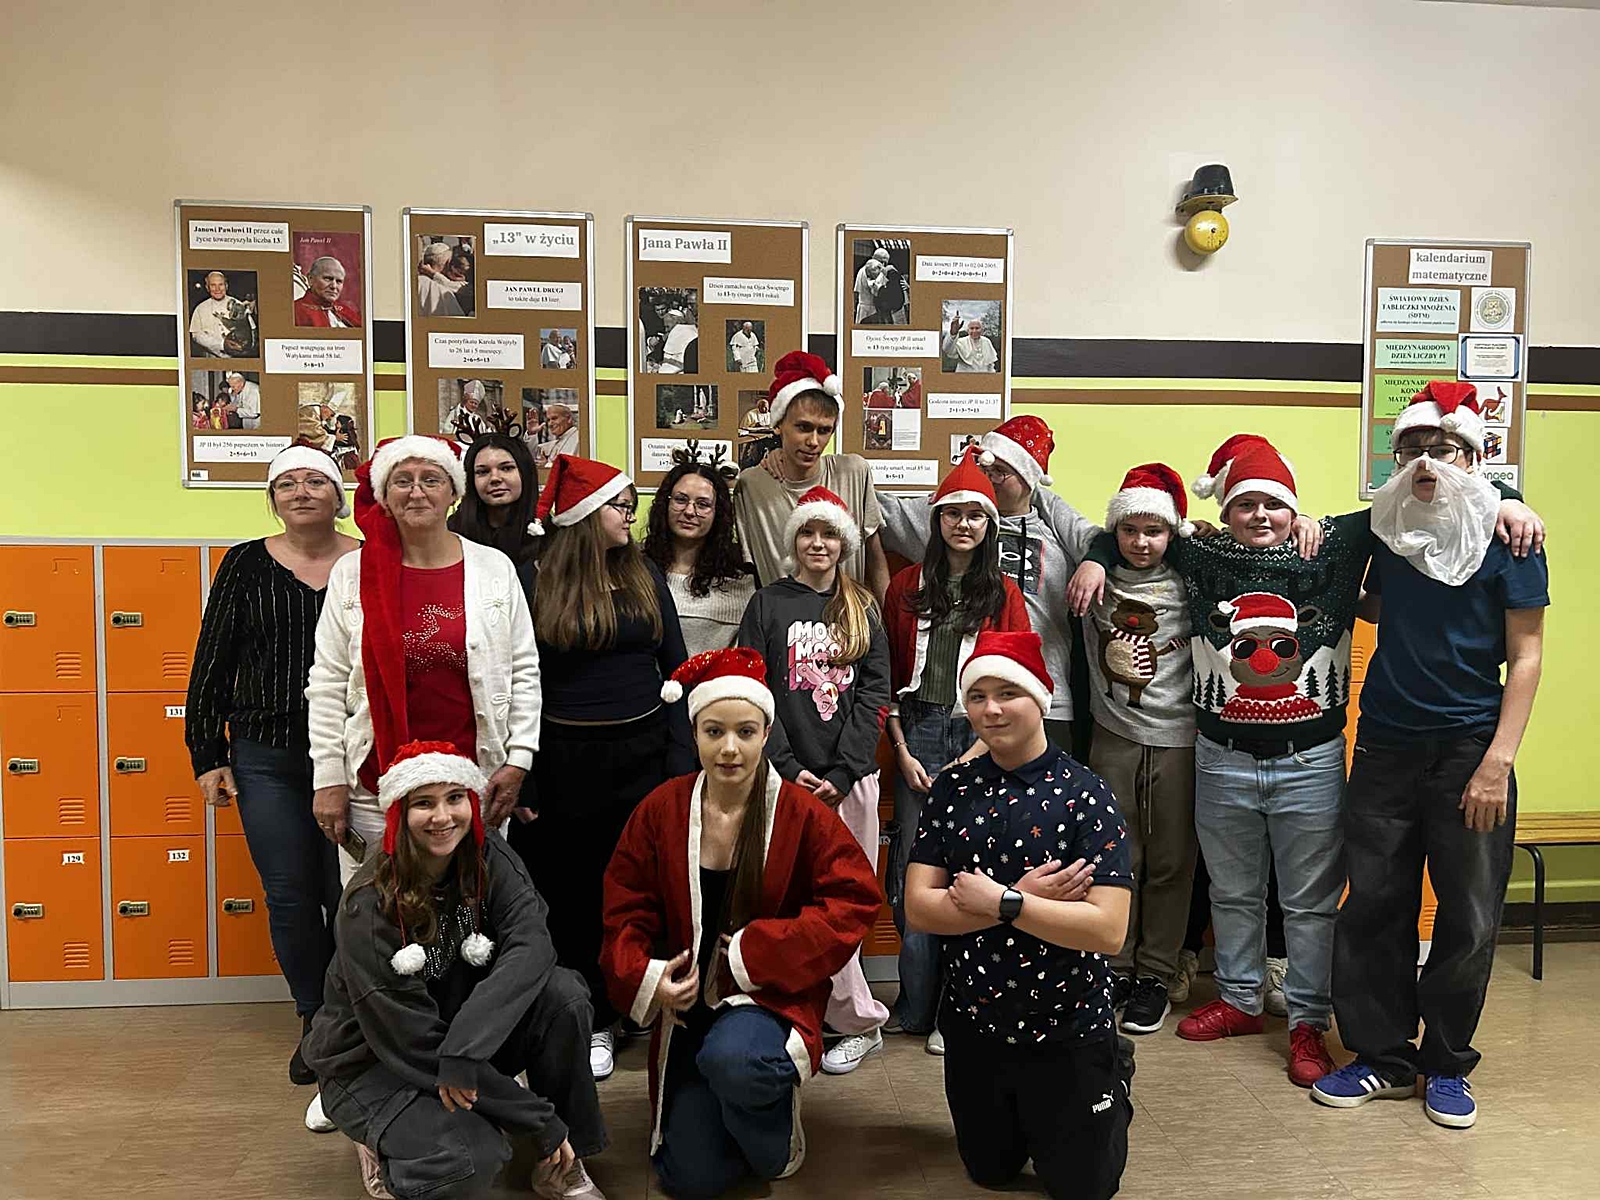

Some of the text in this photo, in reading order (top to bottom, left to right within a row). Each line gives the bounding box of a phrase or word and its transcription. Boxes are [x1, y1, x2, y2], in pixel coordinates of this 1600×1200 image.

[525, 235, 537, 244] w
[539, 233, 575, 247] życiu
[643, 237, 728, 251] Jana Pawła II
[1416, 252, 1486, 264] kalendarium
[1412, 271, 1488, 282] matematyczne
[170, 708, 183, 716] 131
[67, 855, 81, 863] 129
[172, 852, 186, 860] 132
[1092, 1099, 1112, 1114] PUMA
